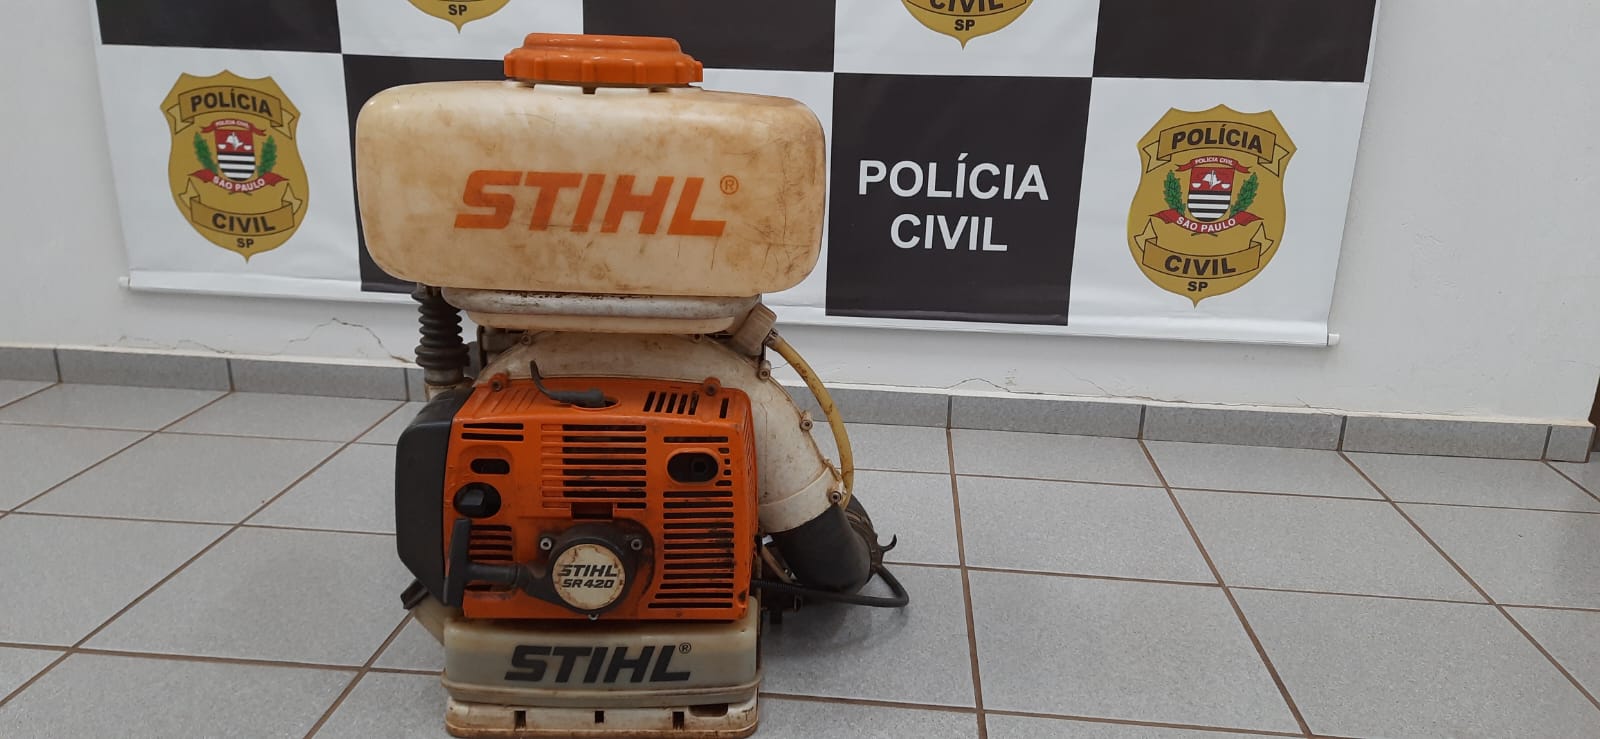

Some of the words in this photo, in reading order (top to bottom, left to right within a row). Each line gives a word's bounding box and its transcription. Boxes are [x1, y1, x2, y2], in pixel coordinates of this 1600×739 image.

[448, 4, 467, 16] SP
[954, 19, 975, 31] SP
[190, 88, 273, 117] POLÍCIA
[1171, 124, 1263, 153] POLÍCIA
[858, 152, 1049, 201] POLÍCIA
[235, 178, 265, 191] PAULO
[212, 212, 276, 233] CIVIL
[1201, 218, 1236, 232] PAULO
[890, 213, 1008, 252] CIVIL
[236, 238, 254, 248] SP
[1164, 255, 1236, 275] CIVIL
[1187, 281, 1208, 292] SP
[558, 564, 618, 577] STIHL
[562, 579, 583, 589] SR
[584, 579, 615, 589] 420
